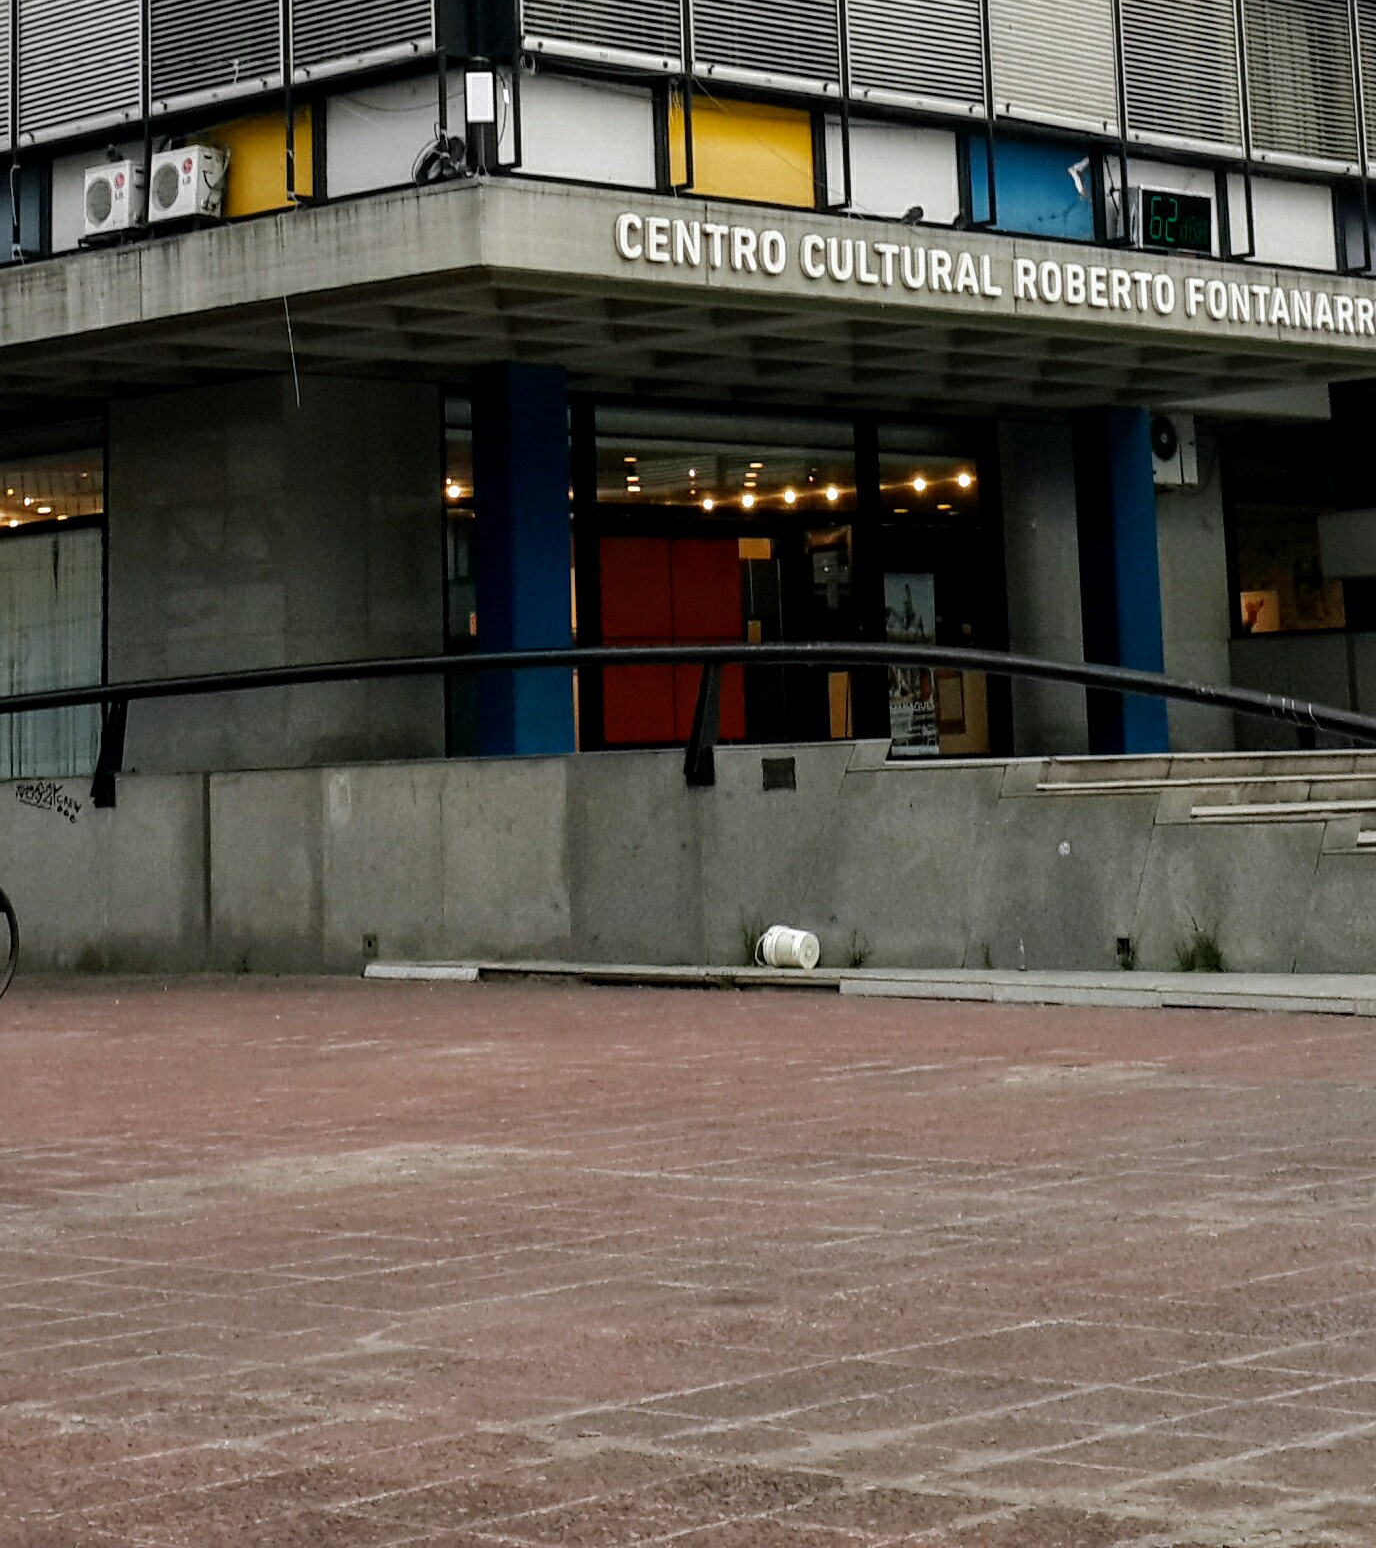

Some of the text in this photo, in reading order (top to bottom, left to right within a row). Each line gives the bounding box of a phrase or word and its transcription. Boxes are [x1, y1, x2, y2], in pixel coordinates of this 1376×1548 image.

[615, 211, 786, 275] CENTRO
[800, 234, 1002, 298] CULTURAL
[1013, 256, 1175, 315] ROBERTO
